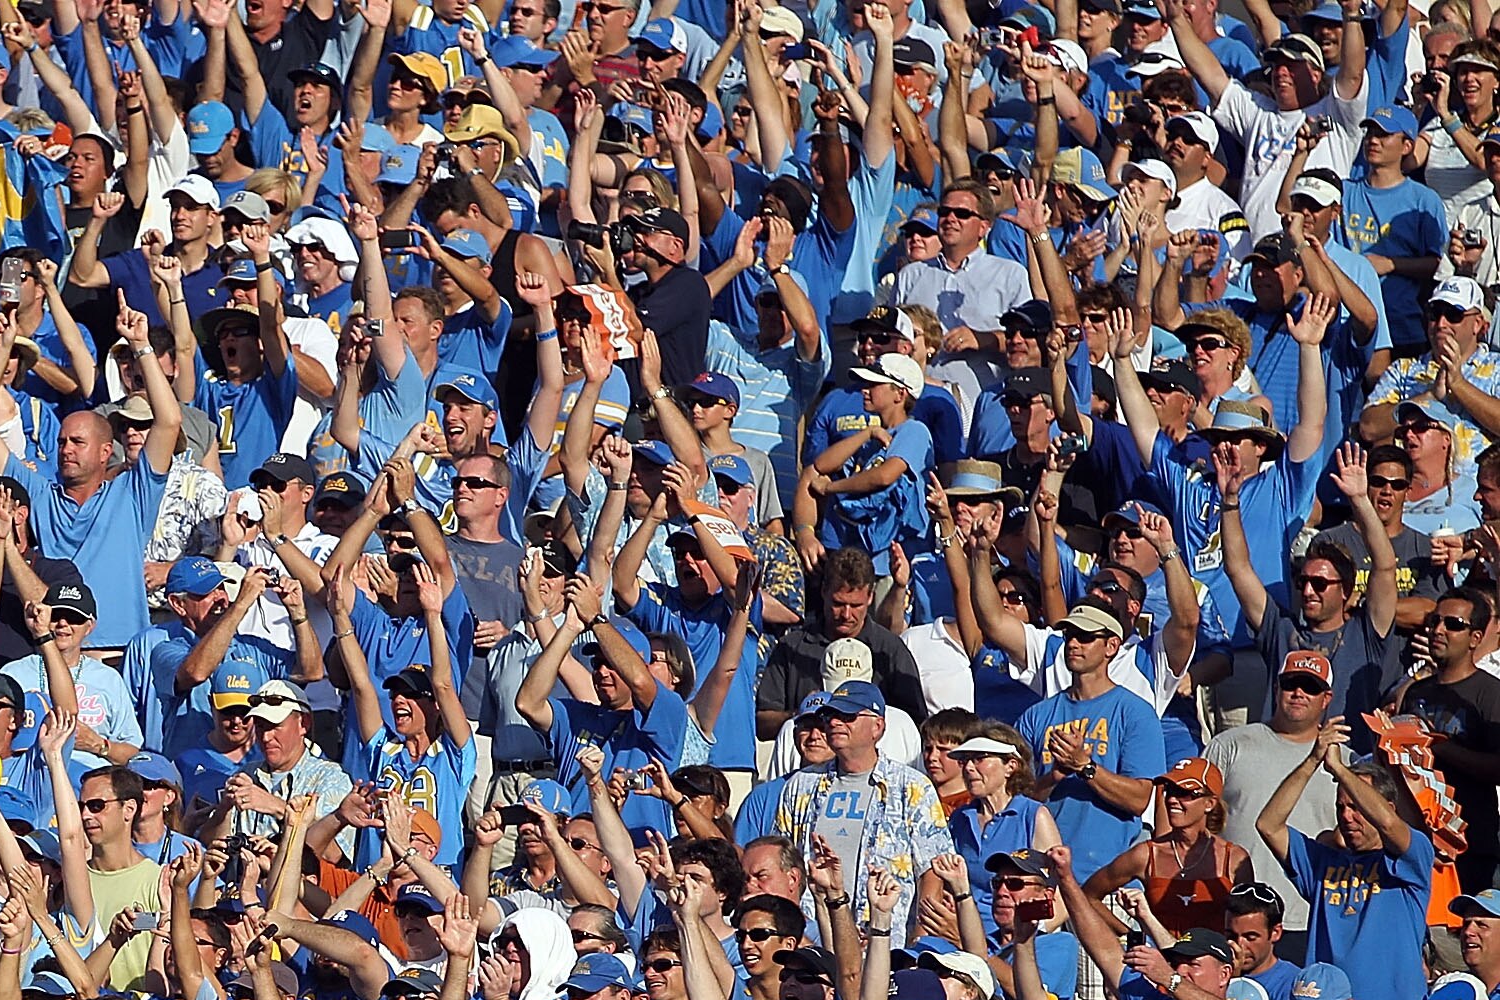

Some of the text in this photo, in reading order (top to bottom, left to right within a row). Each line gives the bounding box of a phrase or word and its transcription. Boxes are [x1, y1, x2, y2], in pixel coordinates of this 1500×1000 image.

[216, 404, 235, 453] 1
[58, 586, 82, 600] Ucla
[836, 659, 861, 669] UCLA
[1292, 661, 1320, 673] TEXAS
[844, 669, 852, 678] B
[226, 675, 249, 689] Ucla
[805, 697, 822, 708] UCL
[825, 791, 864, 819] CL
